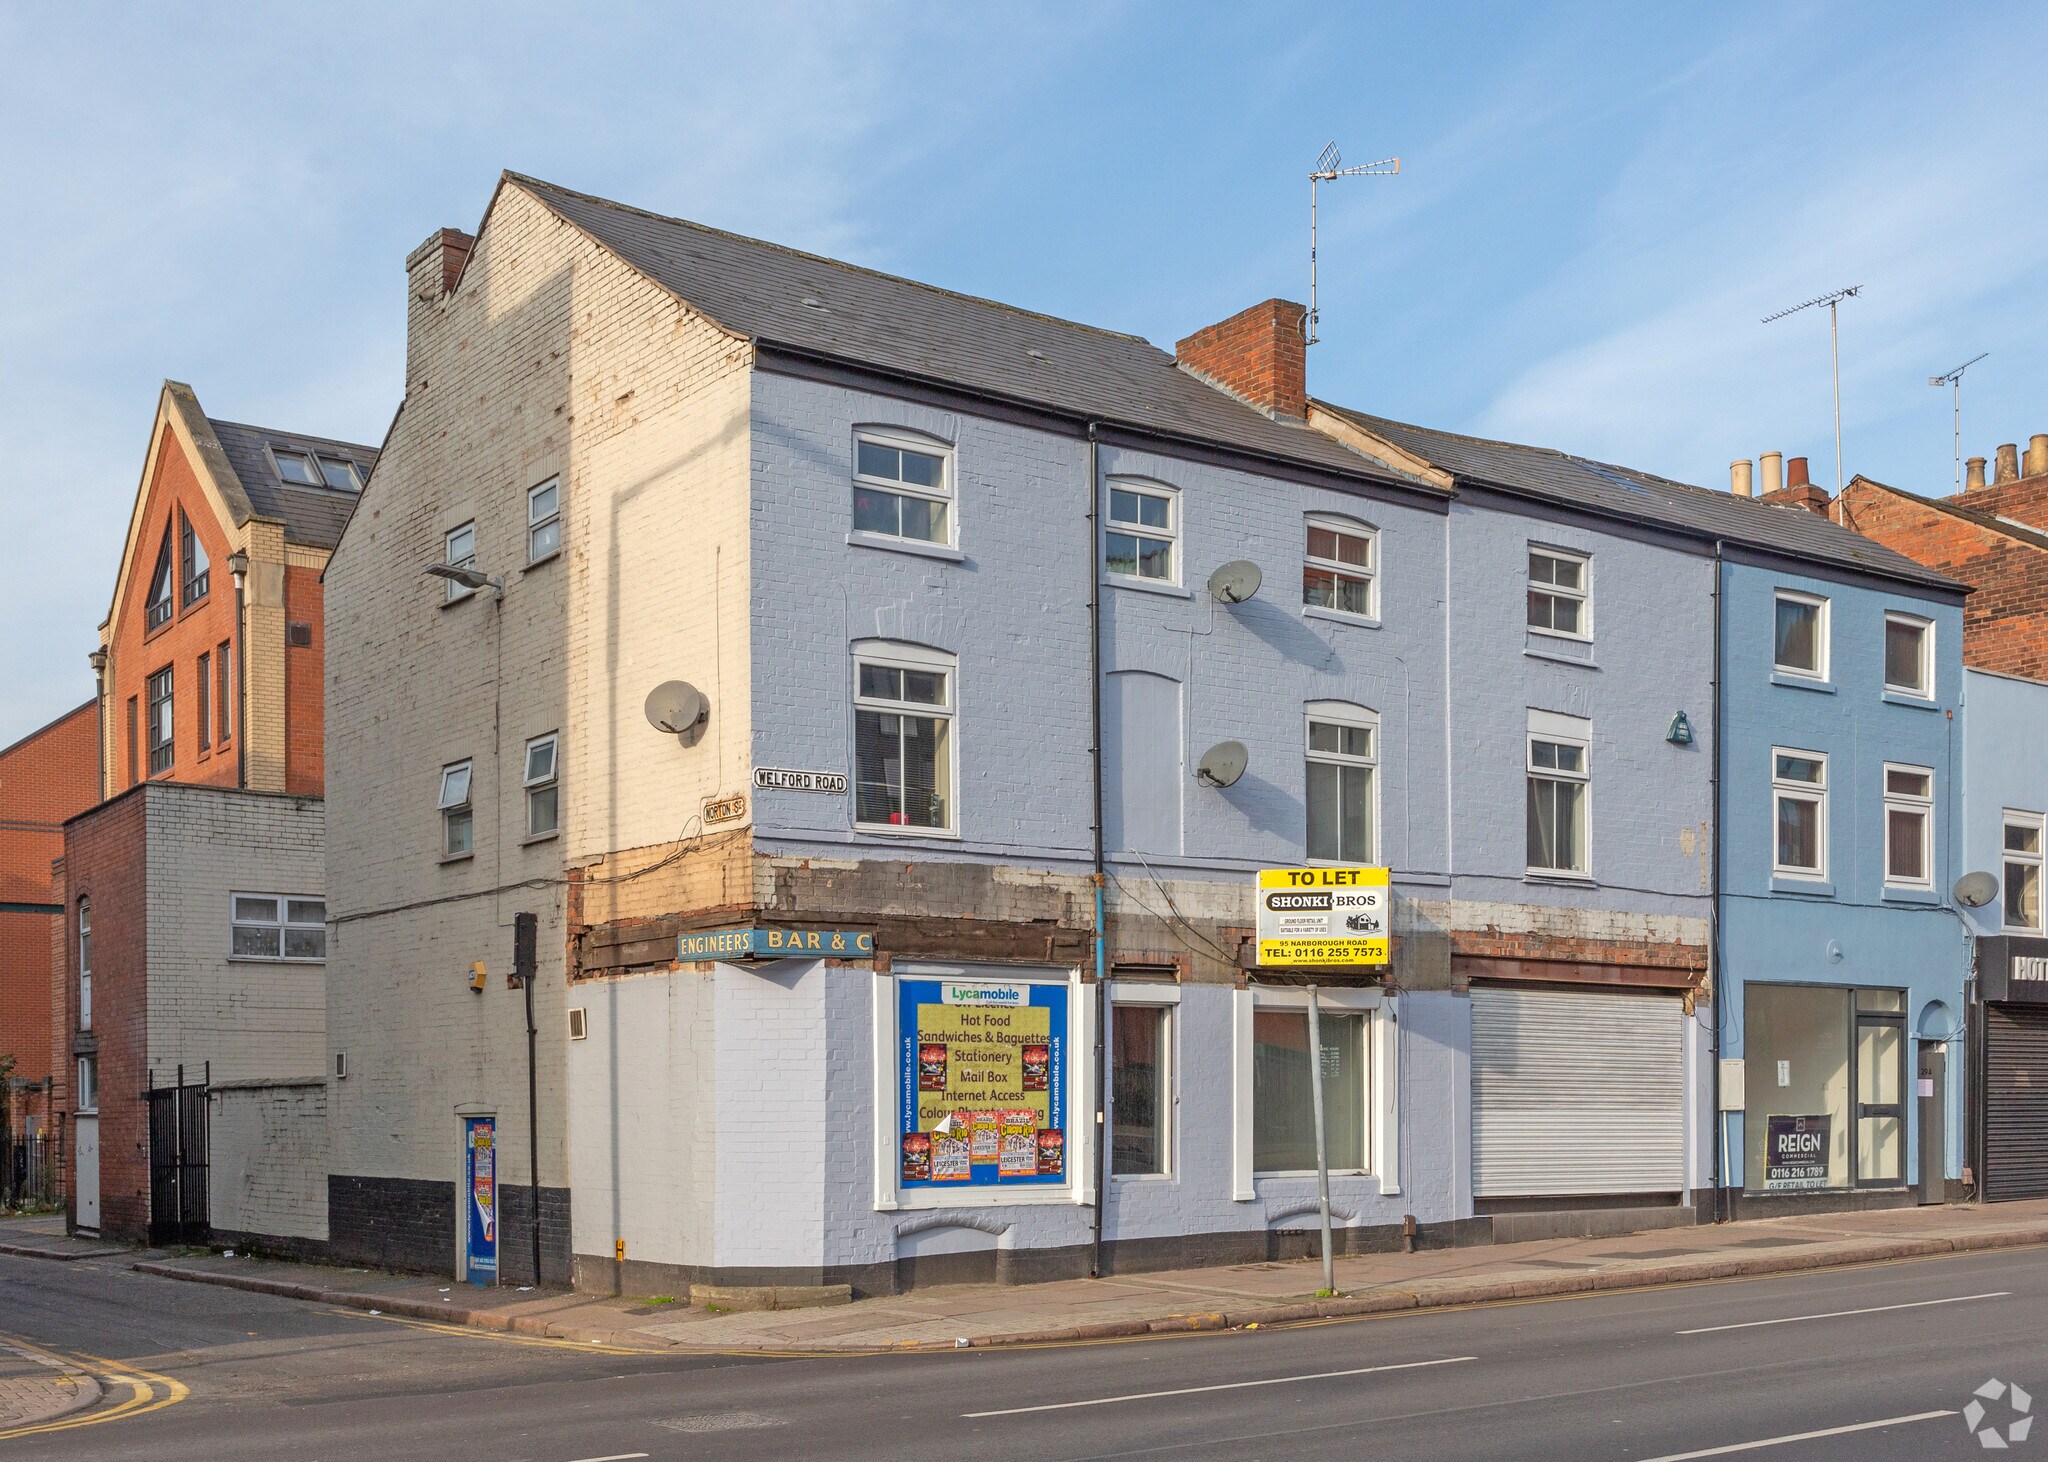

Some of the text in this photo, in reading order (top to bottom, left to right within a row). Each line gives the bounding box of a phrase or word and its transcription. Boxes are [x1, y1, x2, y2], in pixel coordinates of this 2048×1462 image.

[758, 771, 844, 791] WELFORD ROAD
[706, 803, 731, 821] NORTON
[1288, 871, 1360, 886] TO LET
[1271, 896, 1376, 908] SHONKI BROS
[681, 932, 750, 956] ENGINEERS
[768, 931, 870, 951] BAR & C
[1265, 948, 1383, 957] TEL: 0116 255 7573
[952, 987, 1020, 1001] Lycamobile
[961, 1014, 1011, 1027] Hot Food
[917, 1030, 1050, 1046] Sandwiches & Baguettes
[954, 1050, 1012, 1065] Stationery
[960, 1071, 1008, 1083] Mail Box
[941, 1090, 1025, 1102] Internet Access
[1778, 1133, 1821, 1153] REIGN
[1771, 1166, 1824, 1179] 0116 216 1789
[1806, 1180, 1815, 1188] TO
